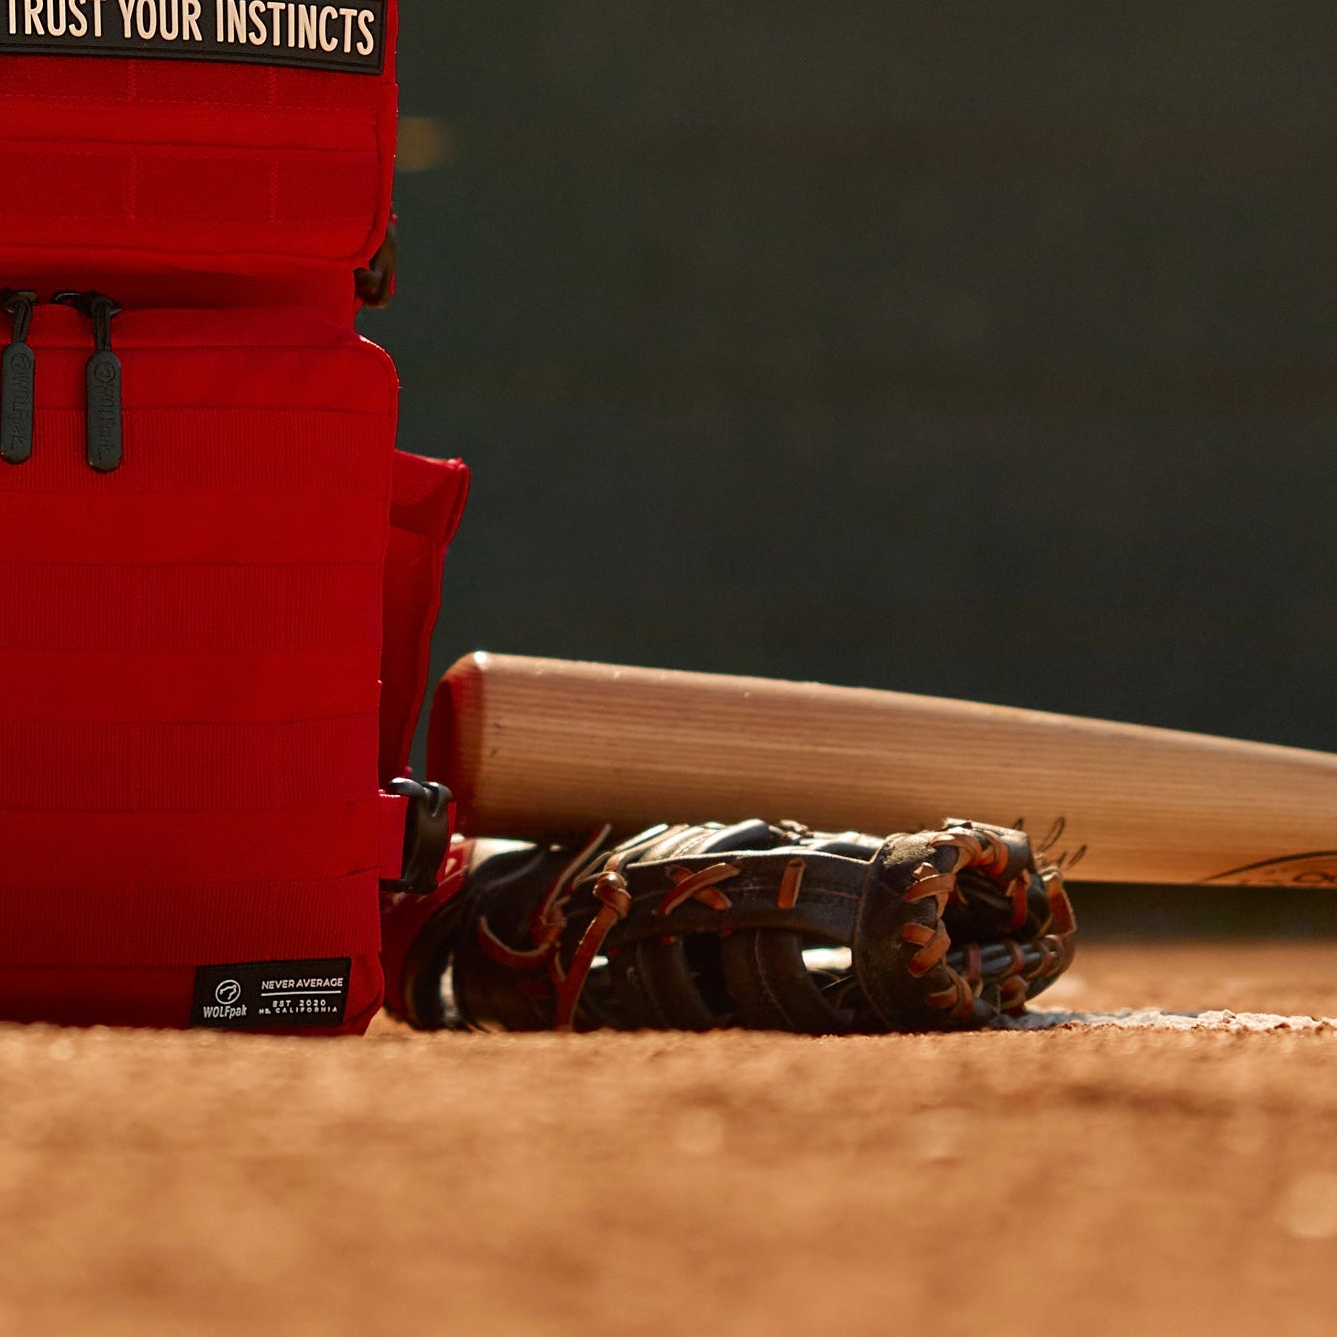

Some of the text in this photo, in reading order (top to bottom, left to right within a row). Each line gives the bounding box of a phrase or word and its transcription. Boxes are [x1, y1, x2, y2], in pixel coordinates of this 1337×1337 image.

[261, 978, 344, 990] NEVER AVERAGE
[298, 999, 327, 1007] 2020
[203, 1004, 248, 1019] WOLFpak
